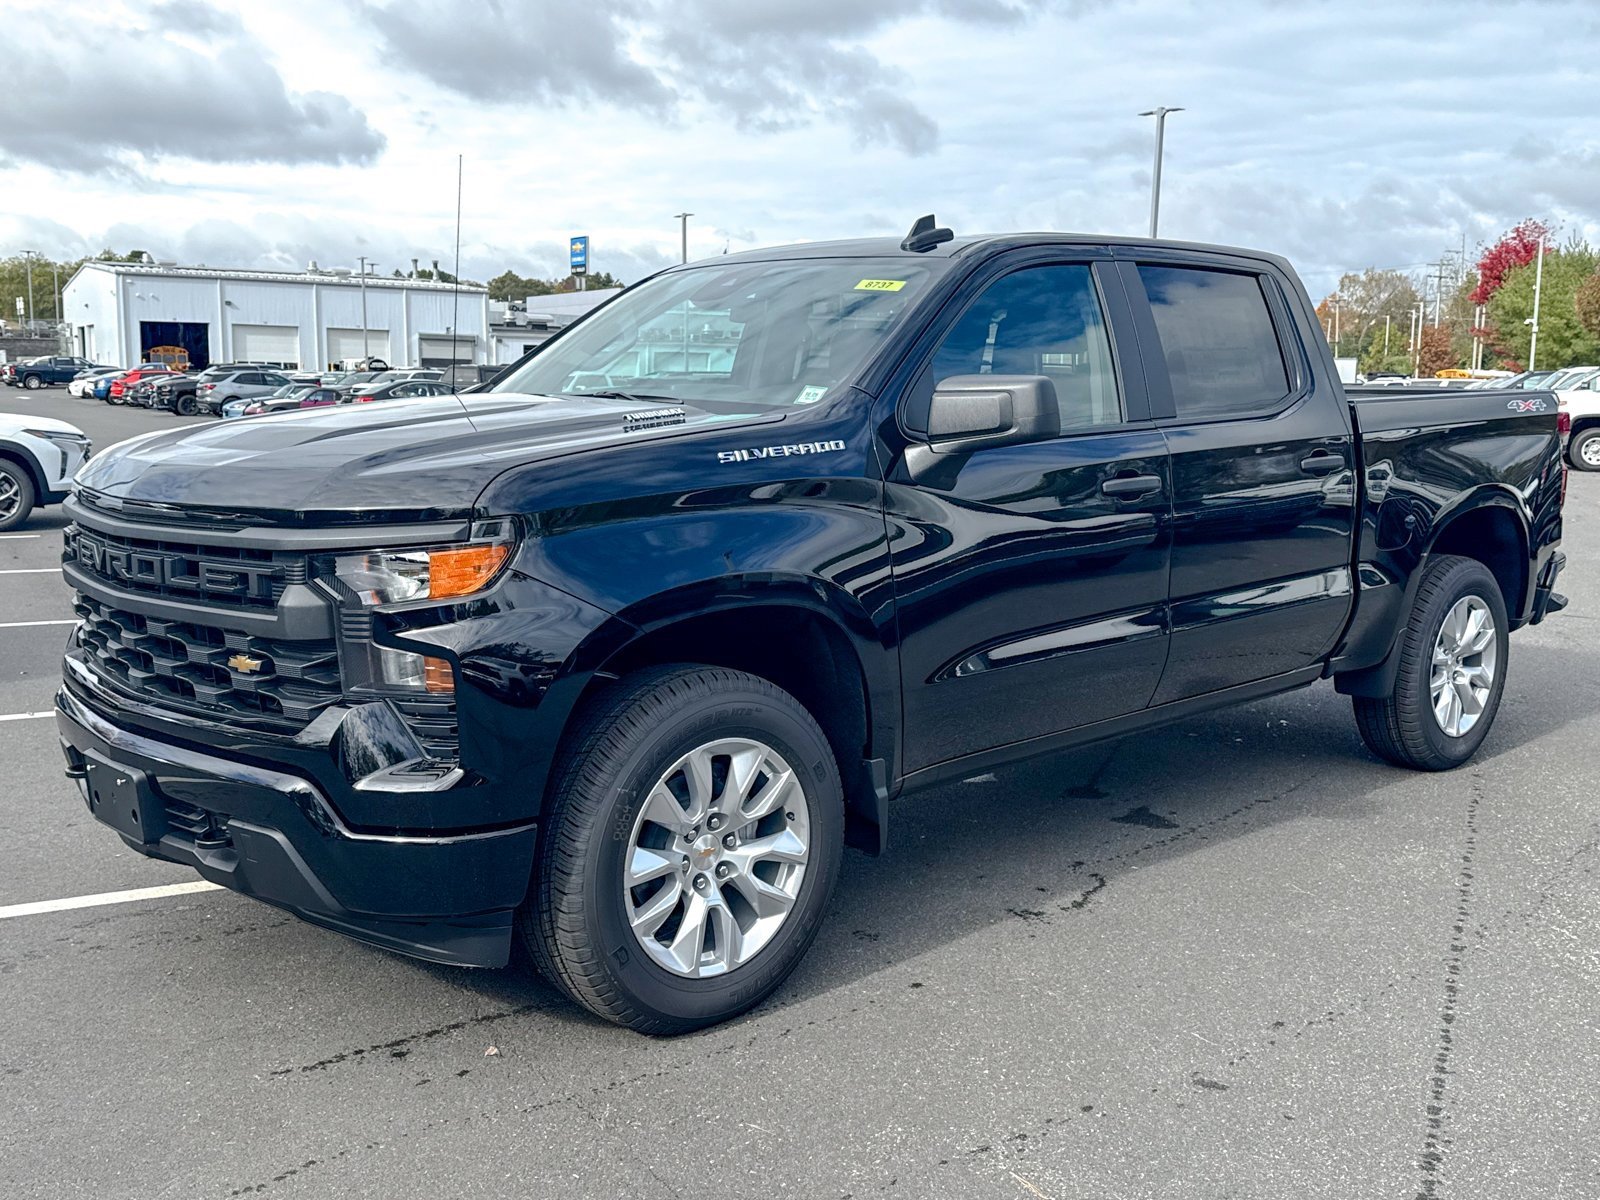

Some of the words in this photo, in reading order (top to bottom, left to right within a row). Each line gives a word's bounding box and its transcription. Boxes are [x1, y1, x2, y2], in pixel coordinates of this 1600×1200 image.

[864, 281, 895, 289] 8737
[622, 407, 686, 423] TURBOMAX
[717, 440, 846, 463] SILVERADO
